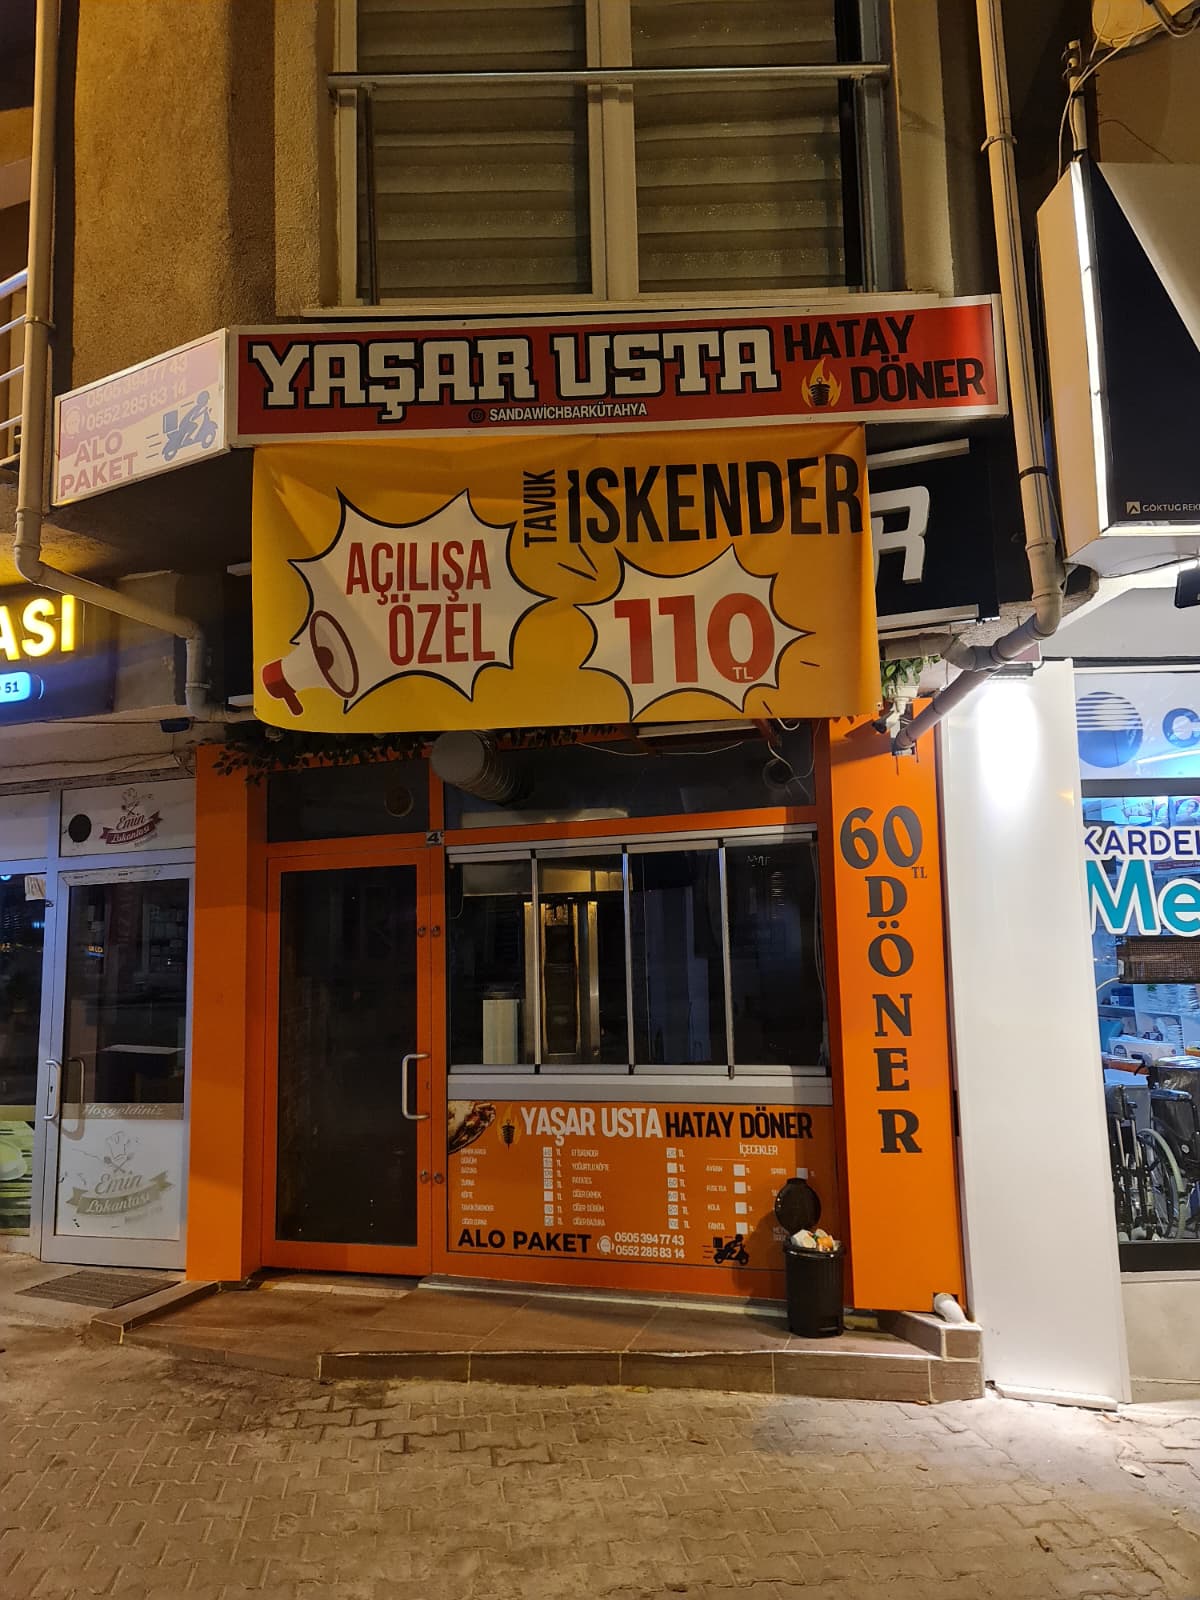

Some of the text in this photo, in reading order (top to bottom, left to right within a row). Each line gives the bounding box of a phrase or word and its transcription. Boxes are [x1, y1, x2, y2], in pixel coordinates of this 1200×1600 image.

[783, 314, 915, 362] HATAY
[250, 328, 780, 422] YAŞAR USTA
[851, 354, 986, 404] DÖNER
[85, 379, 187, 432] 0552 285 83 14
[488, 401, 648, 422] SANDAWİCHBARKÜTAHYA
[74, 431, 123, 468] ALO
[60, 452, 139, 497] PAKET
[522, 469, 557, 548] TAVUK
[567, 453, 864, 544] İSKENDER
[346, 539, 491, 606] AÇILIŞA
[388, 593, 495, 666] ÖZEL
[614, 592, 775, 685] 110
[5, 681, 20, 693] 51
[732, 667, 753, 680] TL
[116, 812, 145, 831] Emin
[839, 805, 923, 872] 60
[911, 866, 928, 879] TL
[866, 876, 922, 1154] DÖNER
[520, 1106, 813, 1146] YAŞAR USTA HATAY DÖNER
[739, 1142, 778, 1157] İÇECEKLER
[95, 1170, 142, 1195] Emin
[458, 1229, 592, 1253] ALO PAKET
[615, 1232, 685, 1246] 0505 394 77 43
[616, 1245, 685, 1259] 0552 285 83 14
